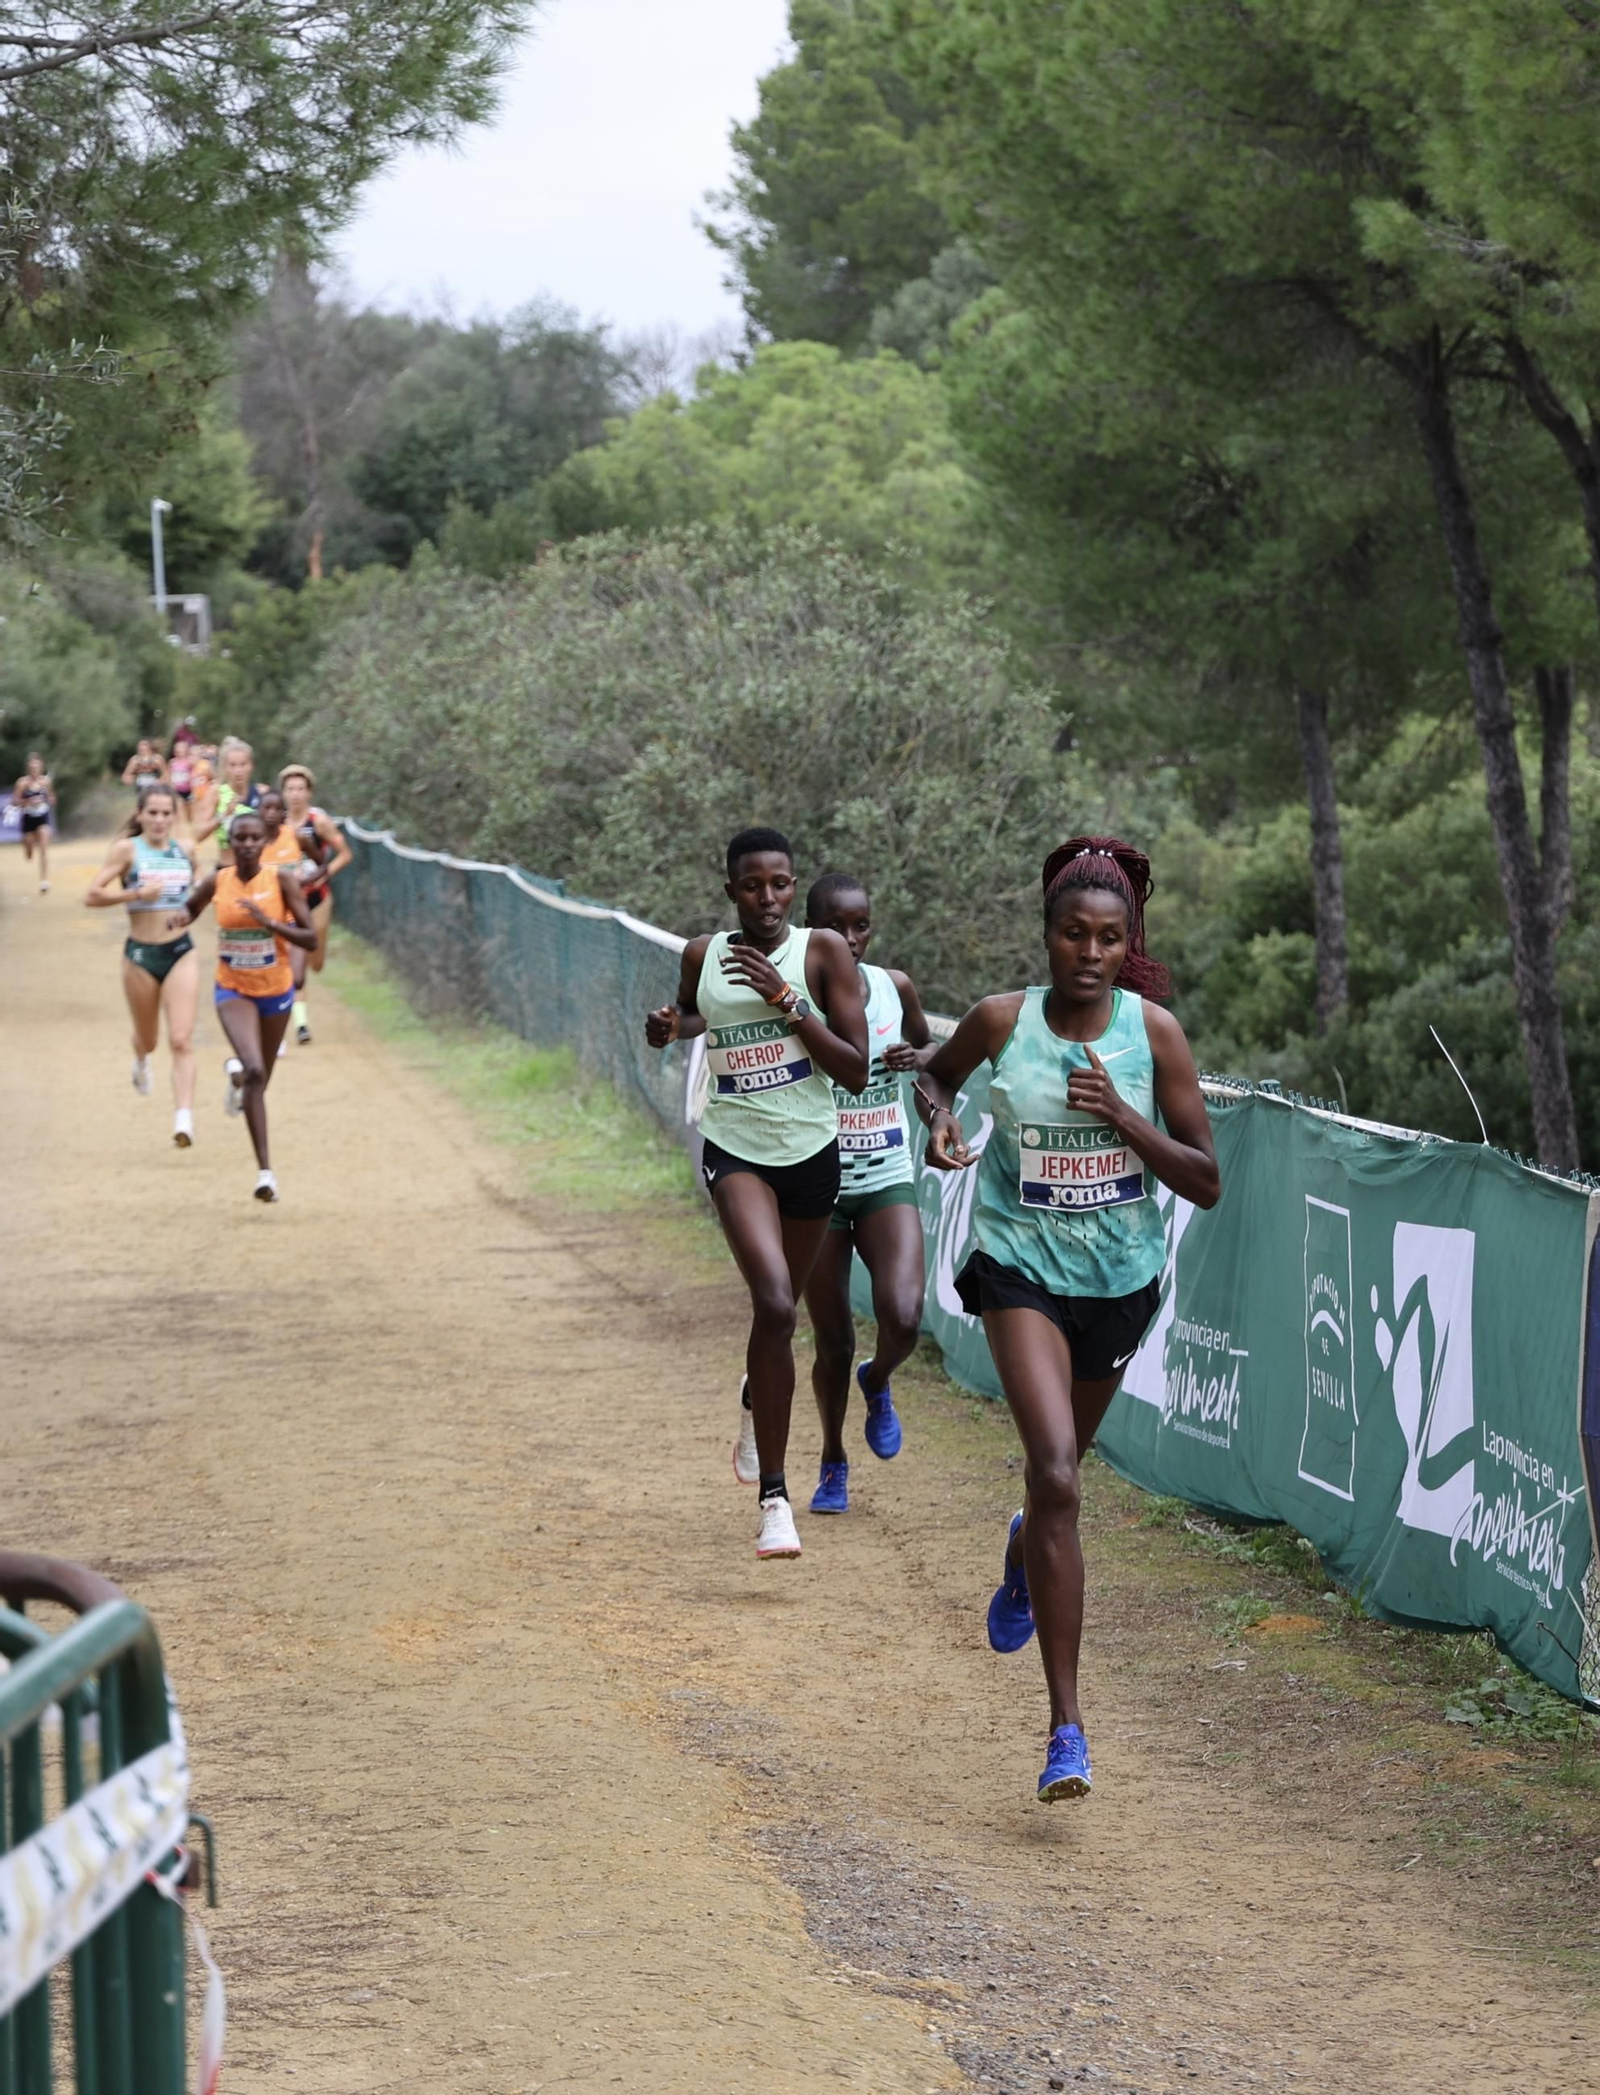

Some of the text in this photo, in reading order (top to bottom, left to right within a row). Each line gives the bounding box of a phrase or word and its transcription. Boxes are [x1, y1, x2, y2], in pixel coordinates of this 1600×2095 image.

[721, 1023, 782, 1045] ITÁLICA
[726, 1043, 785, 1070] CHEROP
[837, 1109, 885, 1130] PKEMOI
[1048, 1129, 1122, 1148] ITÁLICA
[1040, 1151, 1127, 1180] JEPKEMEI
[1213, 1329, 1230, 1352] en
[1312, 1366, 1346, 1411] SEVILLA
[1483, 1420, 1555, 1492] La provincia en
